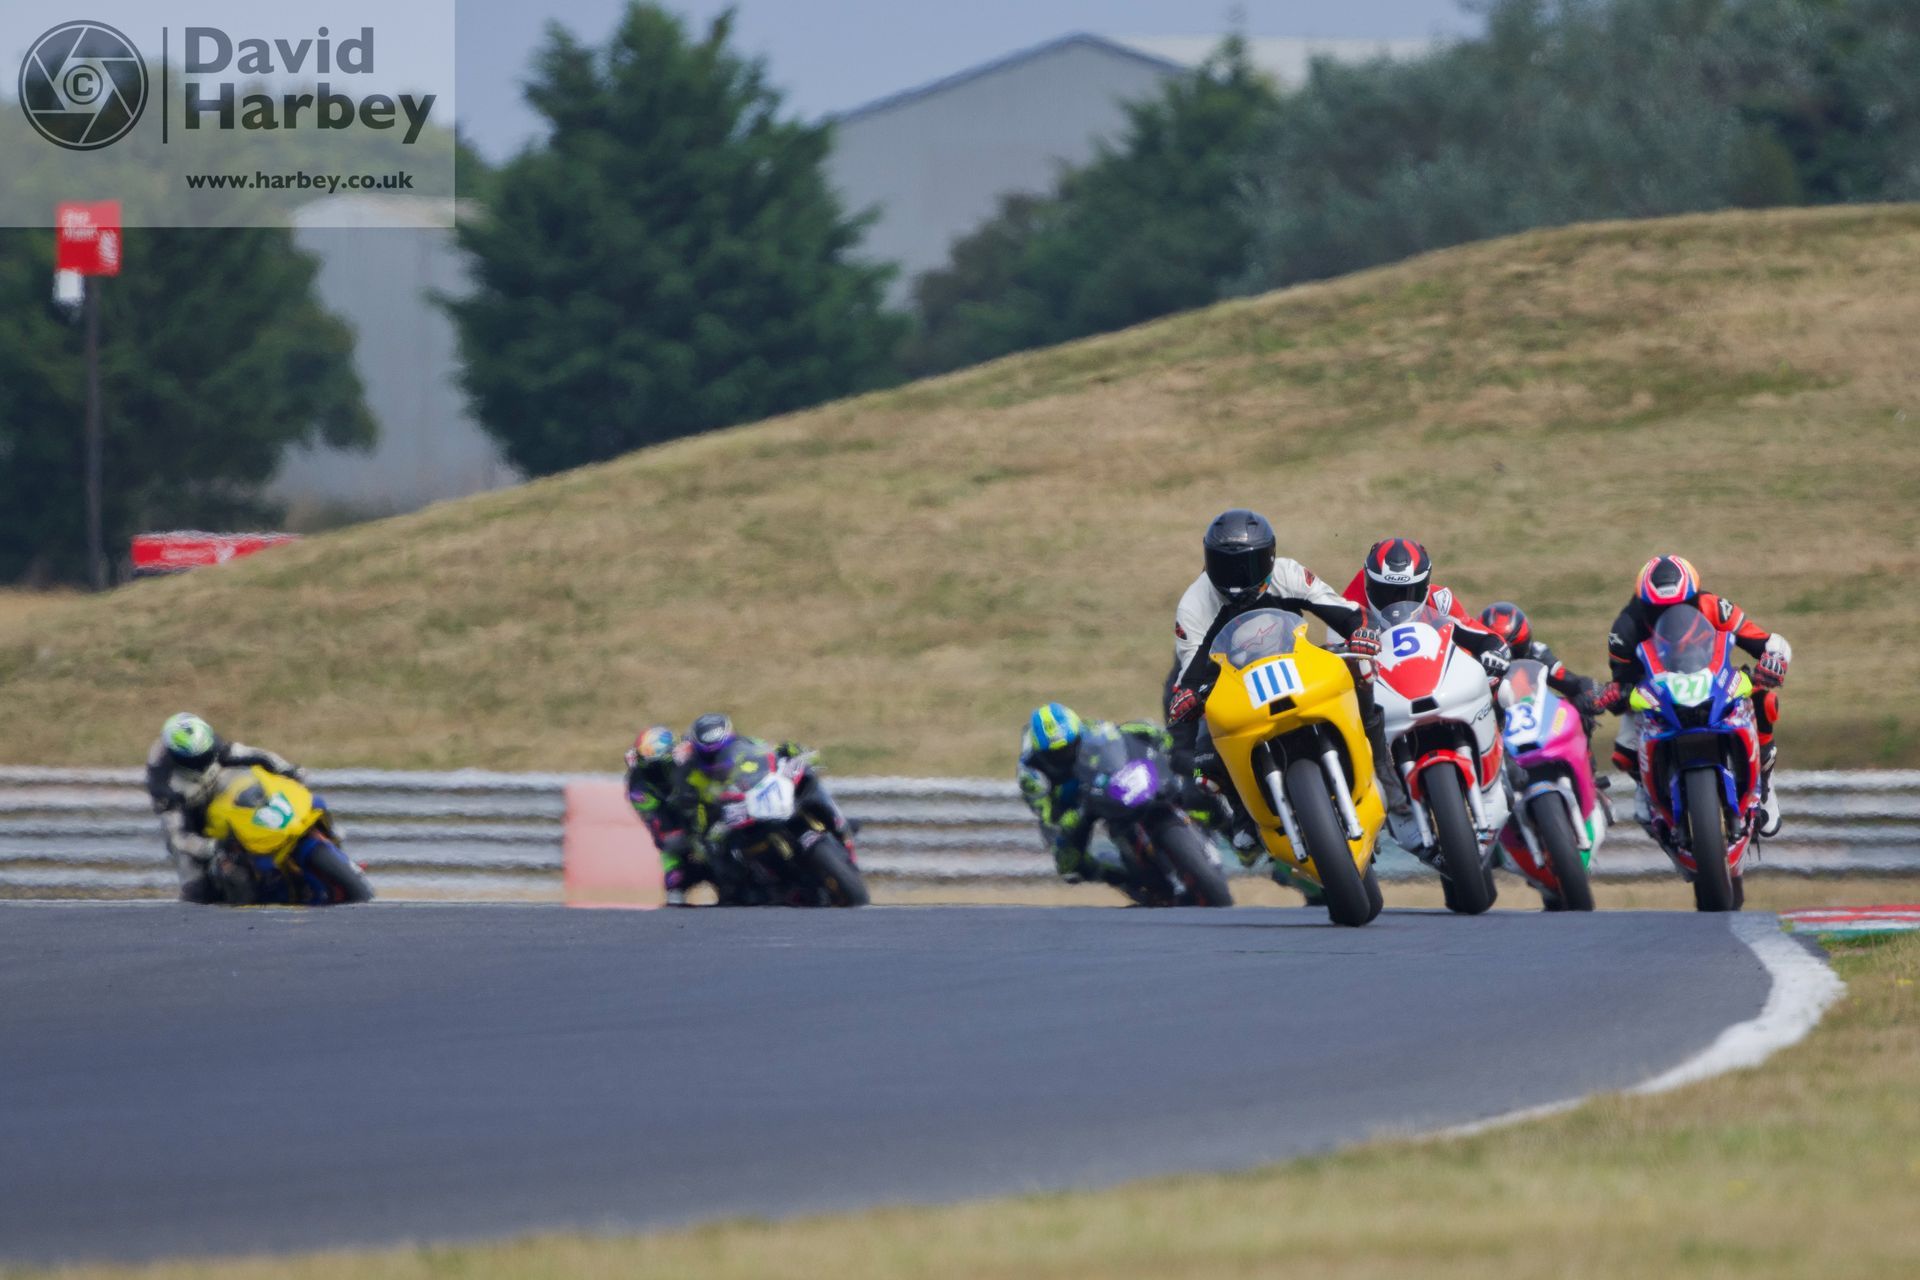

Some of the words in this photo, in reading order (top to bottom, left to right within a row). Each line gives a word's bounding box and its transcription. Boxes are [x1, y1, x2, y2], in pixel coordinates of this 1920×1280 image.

[1391, 626, 1421, 657] 5
[1251, 661, 1295, 702] 111
[1674, 675, 1706, 701] 27
[1503, 703, 1537, 737] 23
